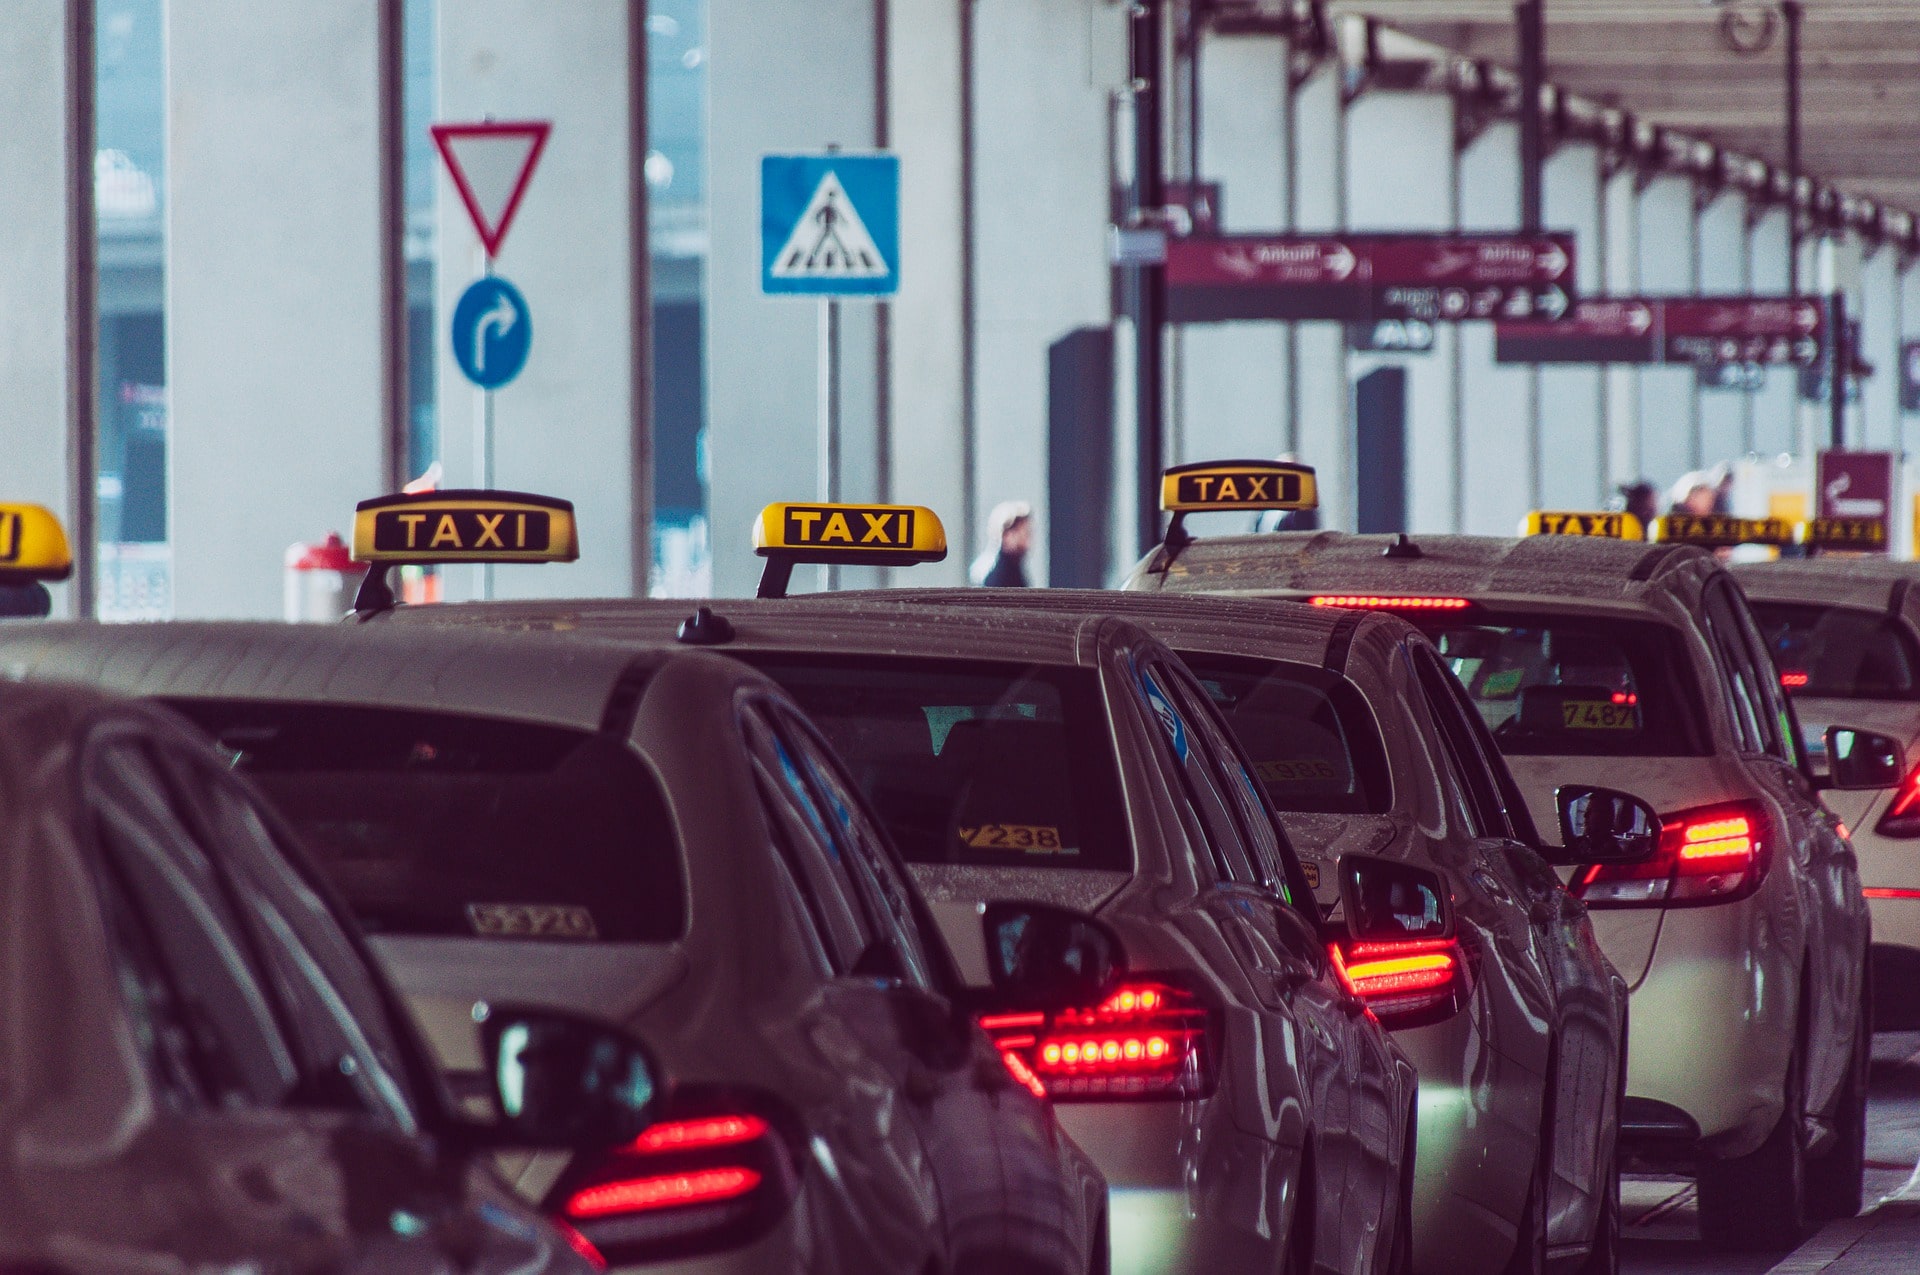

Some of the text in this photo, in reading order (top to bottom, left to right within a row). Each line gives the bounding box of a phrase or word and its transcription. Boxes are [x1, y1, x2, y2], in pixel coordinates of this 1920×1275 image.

[1193, 477, 1284, 501] TAXI
[398, 514, 527, 548] TAXI
[791, 511, 908, 544] TAXI
[1543, 516, 1619, 537] TAXI
[1565, 704, 1630, 725] 7487
[963, 827, 1058, 847] 7238
